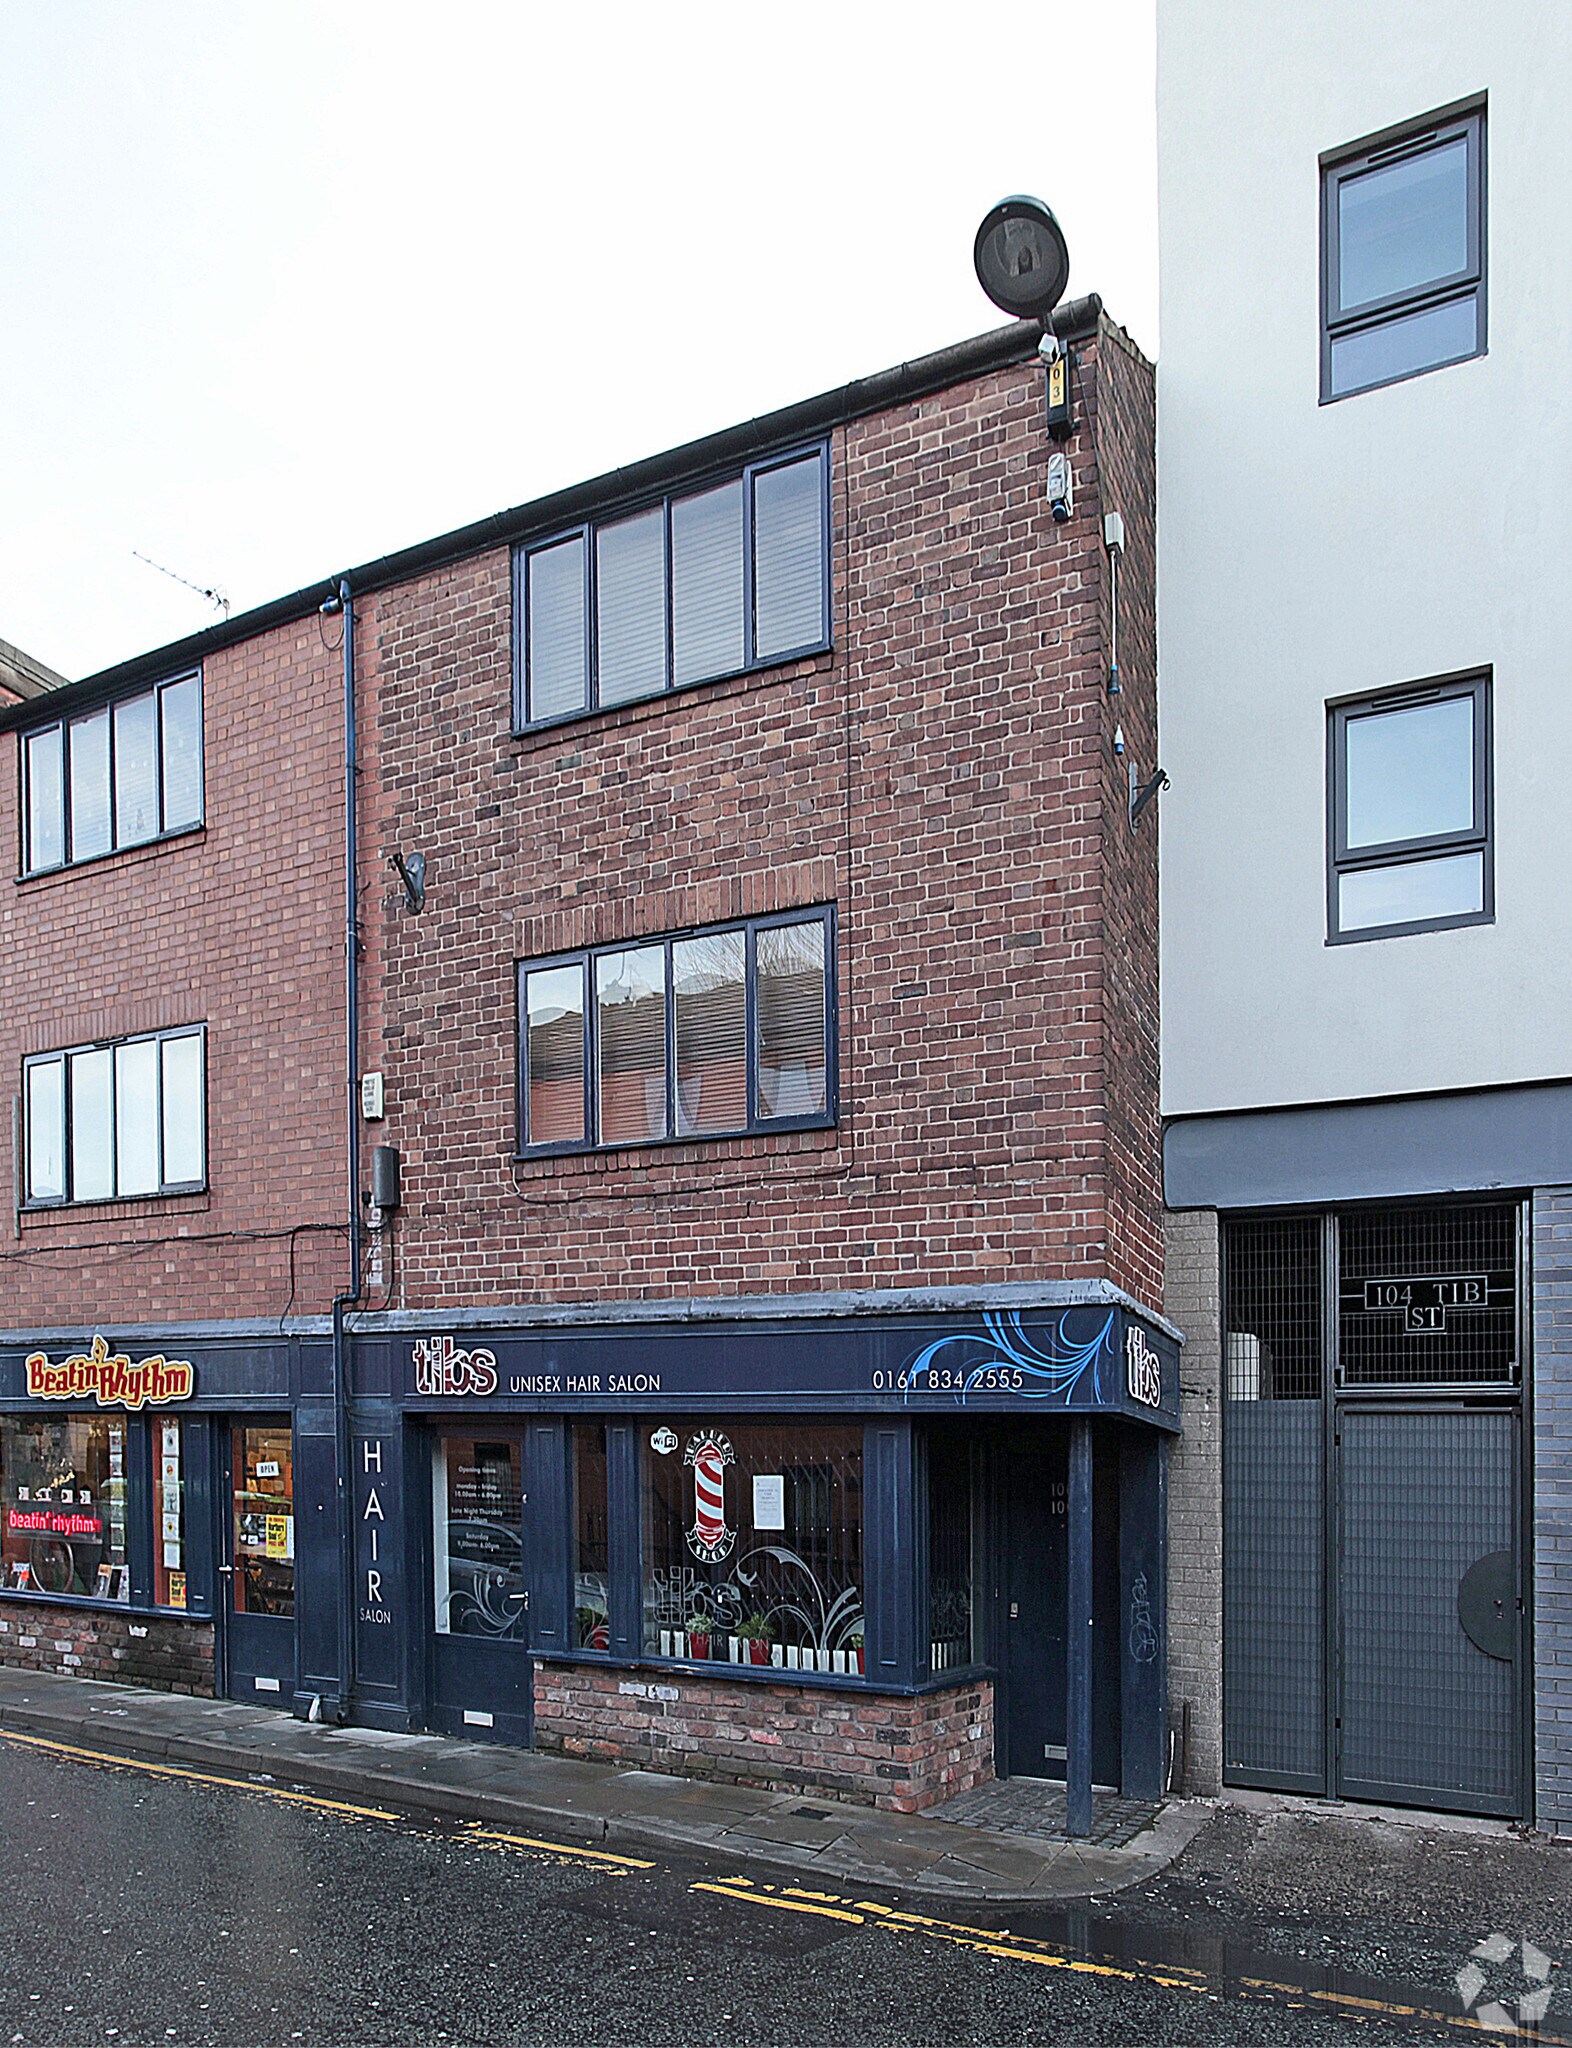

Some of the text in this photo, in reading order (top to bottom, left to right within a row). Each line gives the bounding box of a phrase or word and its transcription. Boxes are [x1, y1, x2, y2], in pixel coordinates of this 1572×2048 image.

[1377, 1282, 1480, 1306] 104 TIB
[1411, 1306, 1440, 1327] ST
[412, 1336, 498, 1396] tibs
[1126, 1325, 1162, 1408] tibs
[98, 1357, 187, 1403] Rhythm
[510, 1374, 660, 1393] UNISEX HAIR SALON
[872, 1369, 1023, 1389] 0161 834 2555
[260, 1463, 275, 1474] OPEN
[458, 1465, 480, 1474] Opening
[463, 1507, 478, 1515] Night
[479, 1508, 503, 1517] Thursday
[1051, 1500, 1069, 1515] 10
[52, 1514, 95, 1537] rhythm
[363, 1440, 385, 1603] HAIR
[465, 1532, 489, 1542] Saturday
[695, 1544, 729, 1561] SHOP
[359, 1606, 391, 1624] SALON
[696, 1632, 723, 1647] HAIR
